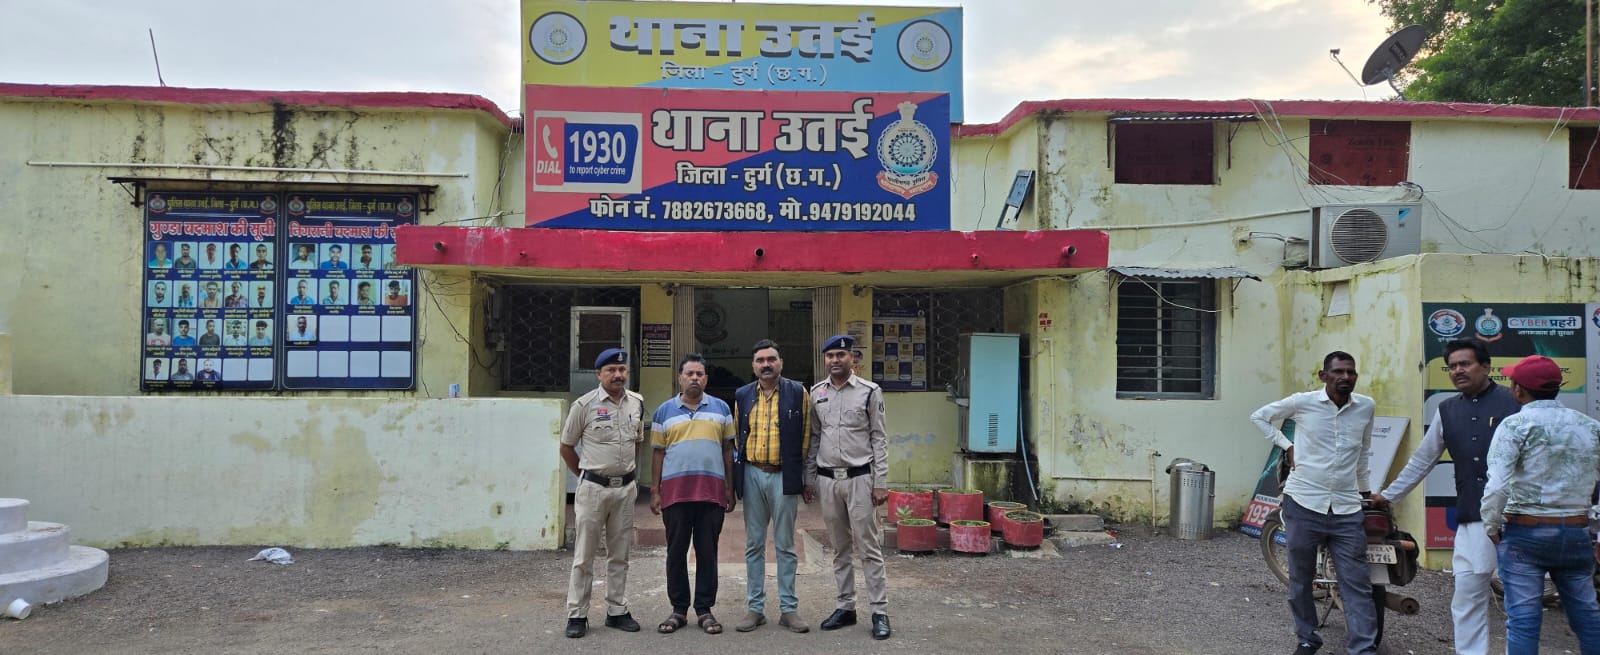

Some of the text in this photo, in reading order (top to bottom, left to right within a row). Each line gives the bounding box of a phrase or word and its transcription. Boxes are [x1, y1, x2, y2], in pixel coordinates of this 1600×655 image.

[610, 12, 876, 63] थाना उतई
[661, 61, 706, 80] जिला
[730, 63, 758, 85] दुर्ग
[768, 63, 827, 86] (छ.ग.)
[652, 98, 874, 160] थाना उतई
[569, 130, 626, 164] 1930
[536, 160, 561, 174] DIAL
[569, 165, 626, 177] to report cyber crime
[676, 161, 727, 185] जिला
[743, 162, 773, 191] दुर्ग
[776, 163, 841, 191] (छ.ग.)
[589, 195, 630, 218] फोन
[633, 196, 656, 219] नं.
[662, 201, 774, 223] 7882673668,
[149, 217, 276, 241] गुण्डा बदमाश की सूची
[288, 221, 334, 238] निगरानी
[334, 225, 373, 239] बदमाश
[374, 222, 390, 239] की
[1510, 316, 1577, 327] CYBER प्रहरी
[1246, 503, 1279, 525] 193
